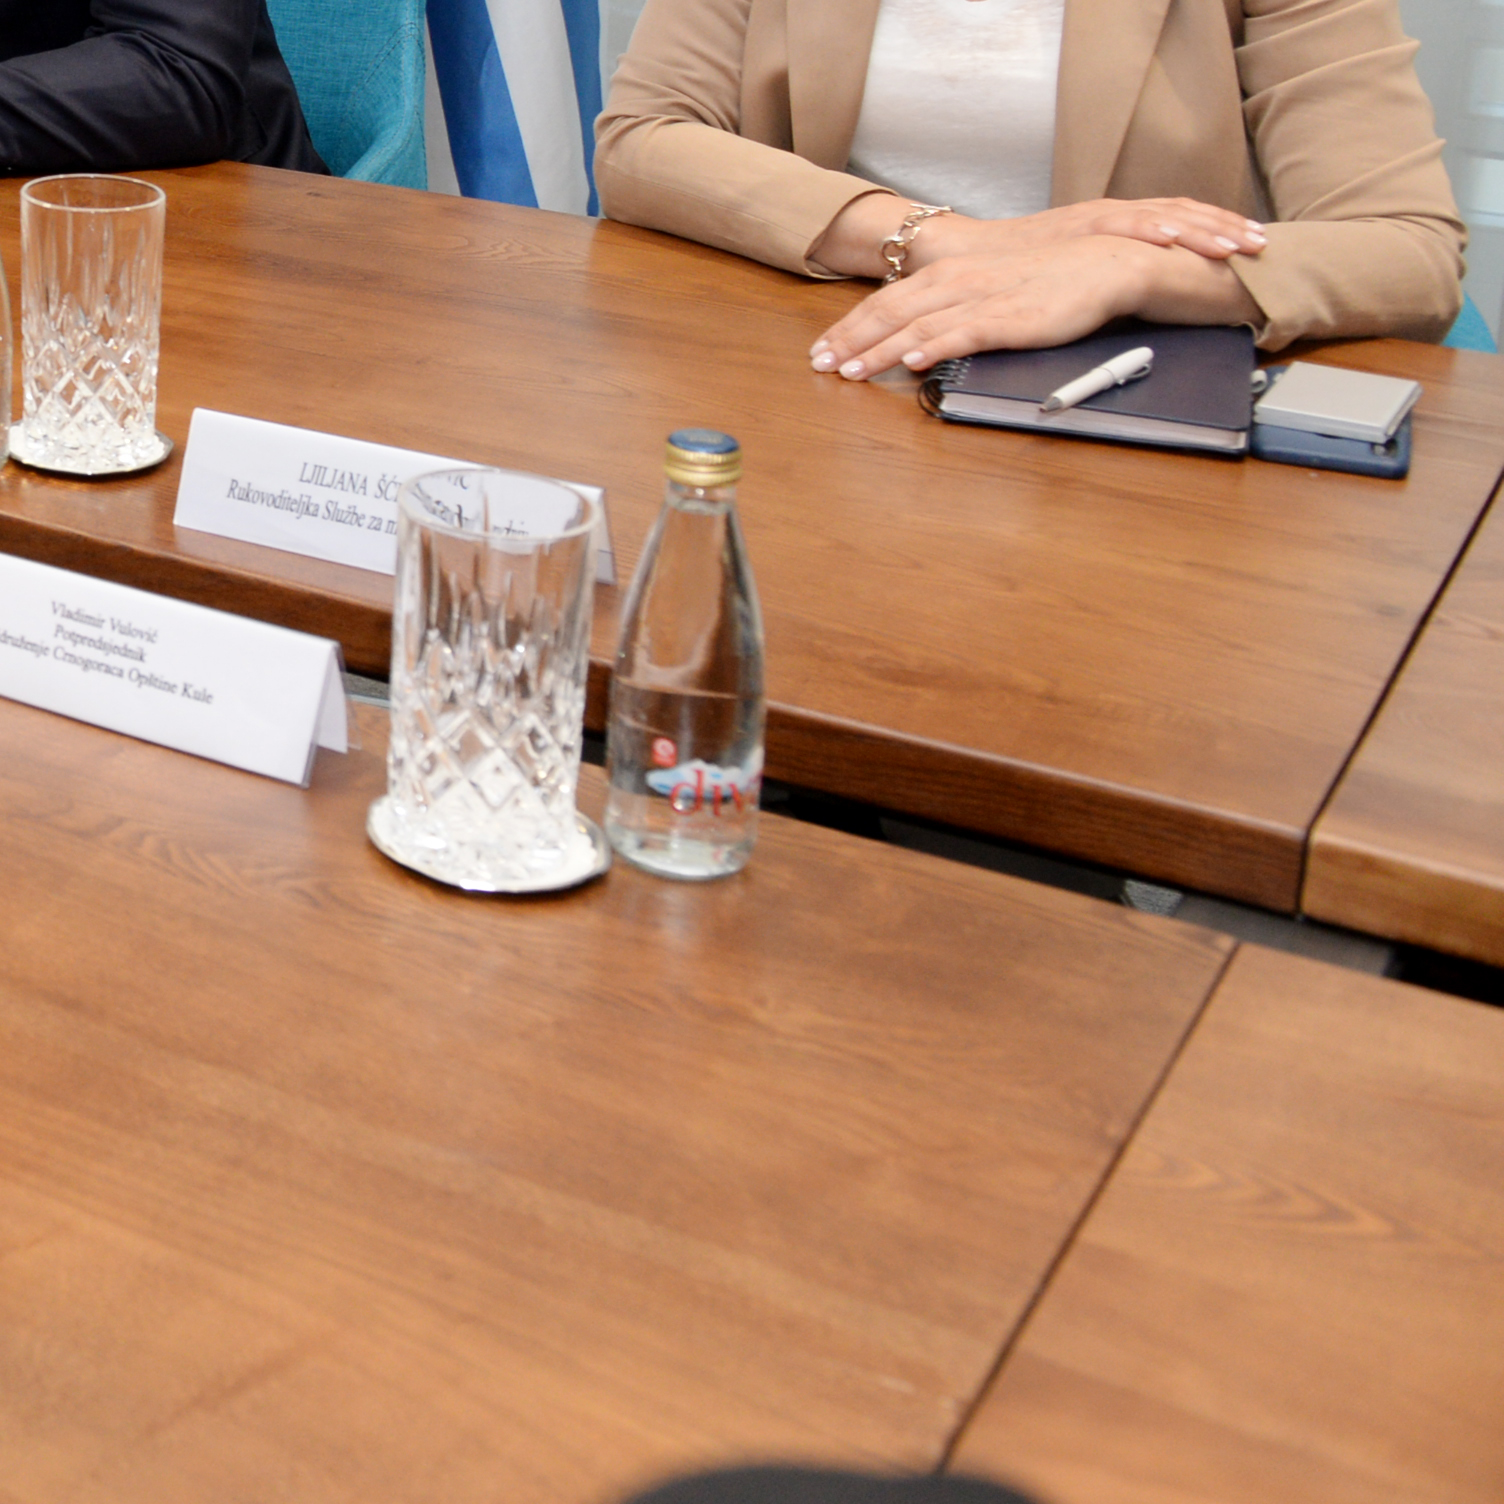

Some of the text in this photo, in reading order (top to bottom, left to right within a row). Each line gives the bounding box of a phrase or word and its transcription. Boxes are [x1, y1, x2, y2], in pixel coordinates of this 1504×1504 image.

[299, 461, 368, 496] LJILJANA
[226, 479, 320, 519] Rukovoditeljka
[322, 500, 366, 528] Službe
[367, 515, 382, 532] za
[51, 600, 159, 644] Vladimir Vulović
[53, 624, 146, 663] Potpredsjednik
[53, 646, 124, 679] Crnogoraca
[128, 667, 178, 694] Opštine
[181, 682, 214, 705] Kule
